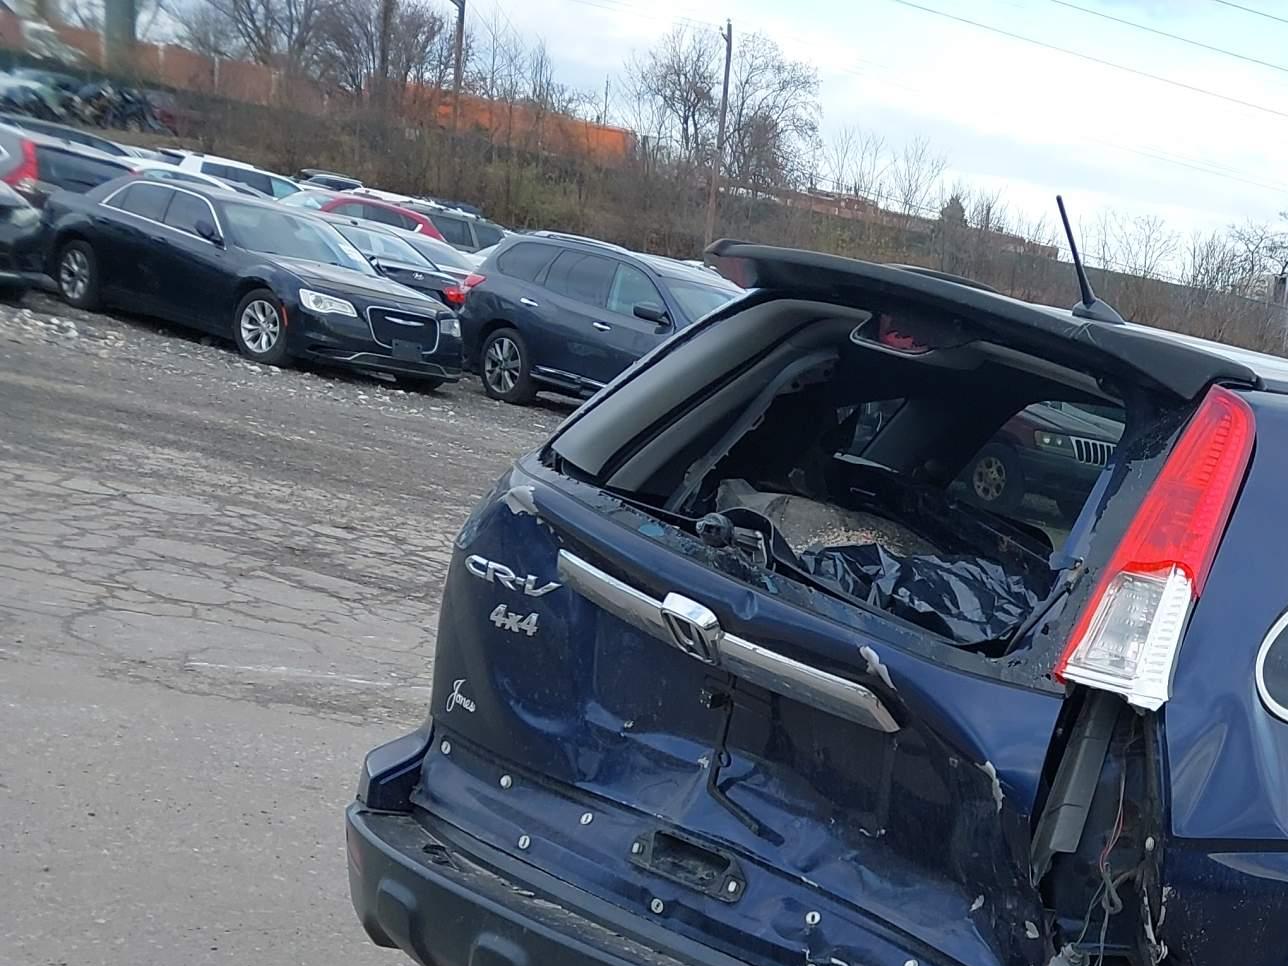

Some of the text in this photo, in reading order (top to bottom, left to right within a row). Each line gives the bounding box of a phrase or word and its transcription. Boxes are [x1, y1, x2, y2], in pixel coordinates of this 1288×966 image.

[465, 555, 562, 597] CR-V
[489, 604, 540, 637] 4x4
[446, 679, 477, 713] Jones
